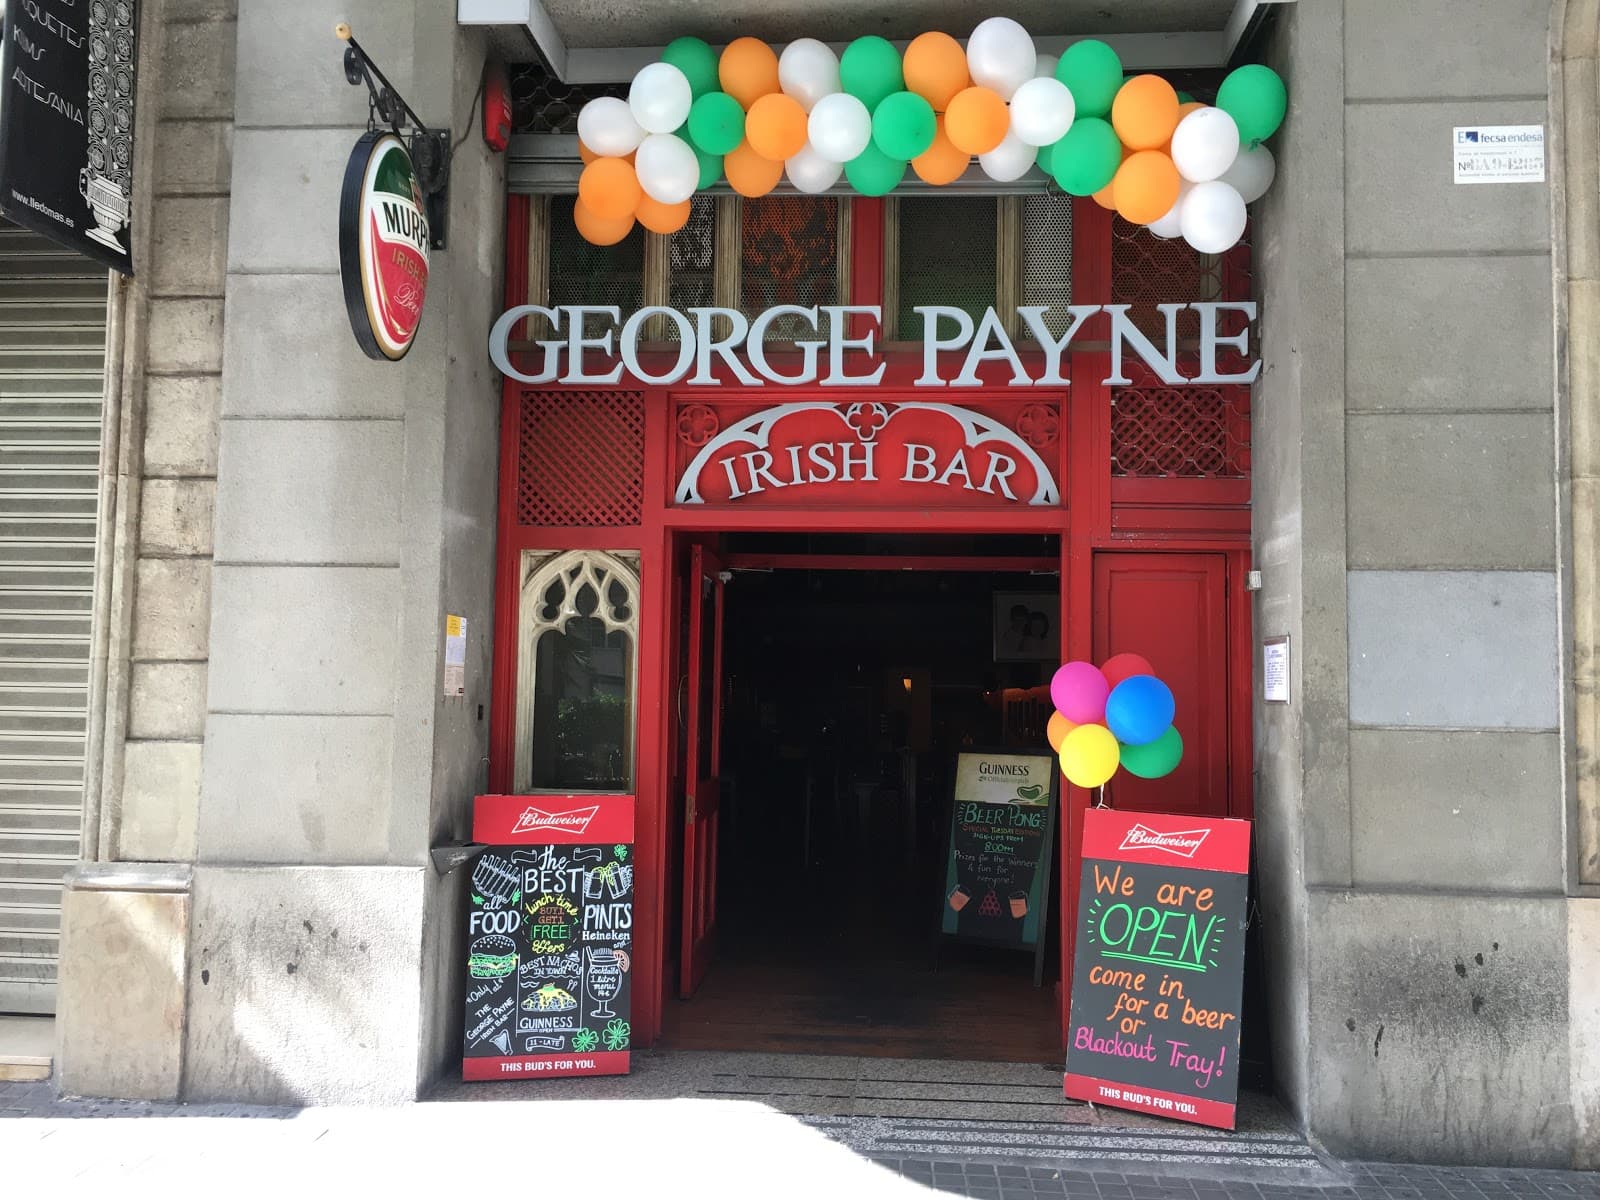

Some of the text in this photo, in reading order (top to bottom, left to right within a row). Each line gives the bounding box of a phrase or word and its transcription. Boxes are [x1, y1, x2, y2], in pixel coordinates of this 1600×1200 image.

[1480, 133, 1507, 143] fecsa
[1507, 132, 1543, 142] endesa
[488, 301, 1263, 387] GEORGE PAYNE
[718, 441, 1018, 501] IRISH BAR
[979, 762, 1029, 776] GUINNESS
[520, 812, 591, 826] Budweiser
[964, 803, 1040, 828] BEER PONG
[1127, 829, 1202, 848] Budweiser
[525, 868, 584, 894] BEST
[1094, 864, 1214, 912] We are
[470, 910, 521, 935] FOOD
[533, 925, 568, 939] FREE
[1099, 903, 1217, 963] OPEN
[582, 930, 631, 941] Heineken
[520, 955, 546, 974] BEST
[1159, 974, 1185, 999] in
[475, 1004, 493, 1019] THE
[1106, 992, 1236, 1030] for a beer
[520, 1016, 573, 1029] GUINNESS
[1120, 1017, 1146, 1035] or
[500, 1059, 596, 1072] THIS BUD'S FOR YOU.
[1074, 1026, 1226, 1089] Blackout Tray!
[1099, 1086, 1198, 1115] THIS BUD'S FOR YOU.
